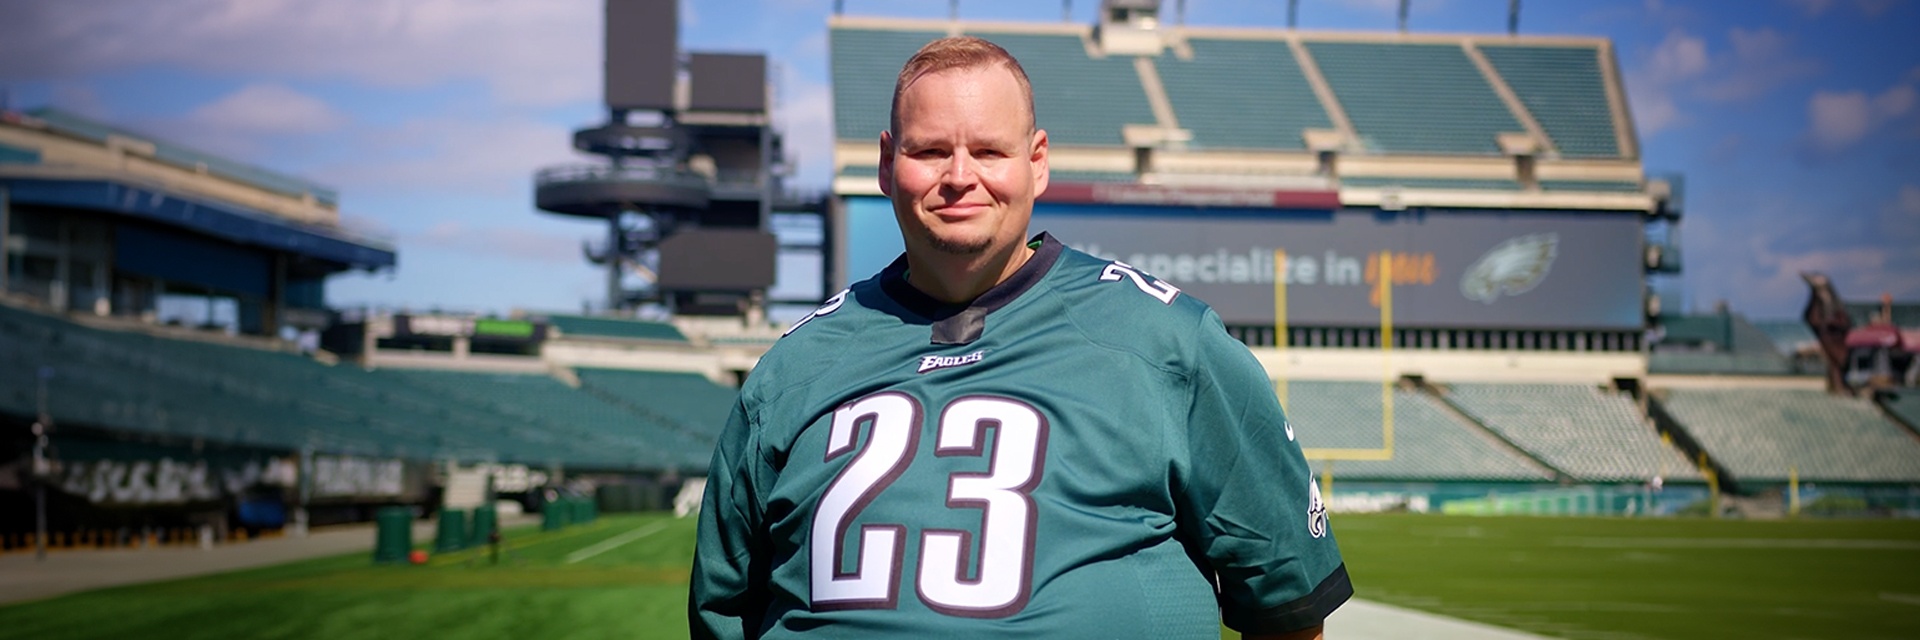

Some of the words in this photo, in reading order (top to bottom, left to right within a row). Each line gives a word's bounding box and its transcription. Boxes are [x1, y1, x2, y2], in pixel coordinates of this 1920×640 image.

[1098, 260, 1181, 306] 2
[1324, 250, 1361, 285] in
[917, 349, 985, 374] EAGLES
[810, 389, 1050, 620] 23
